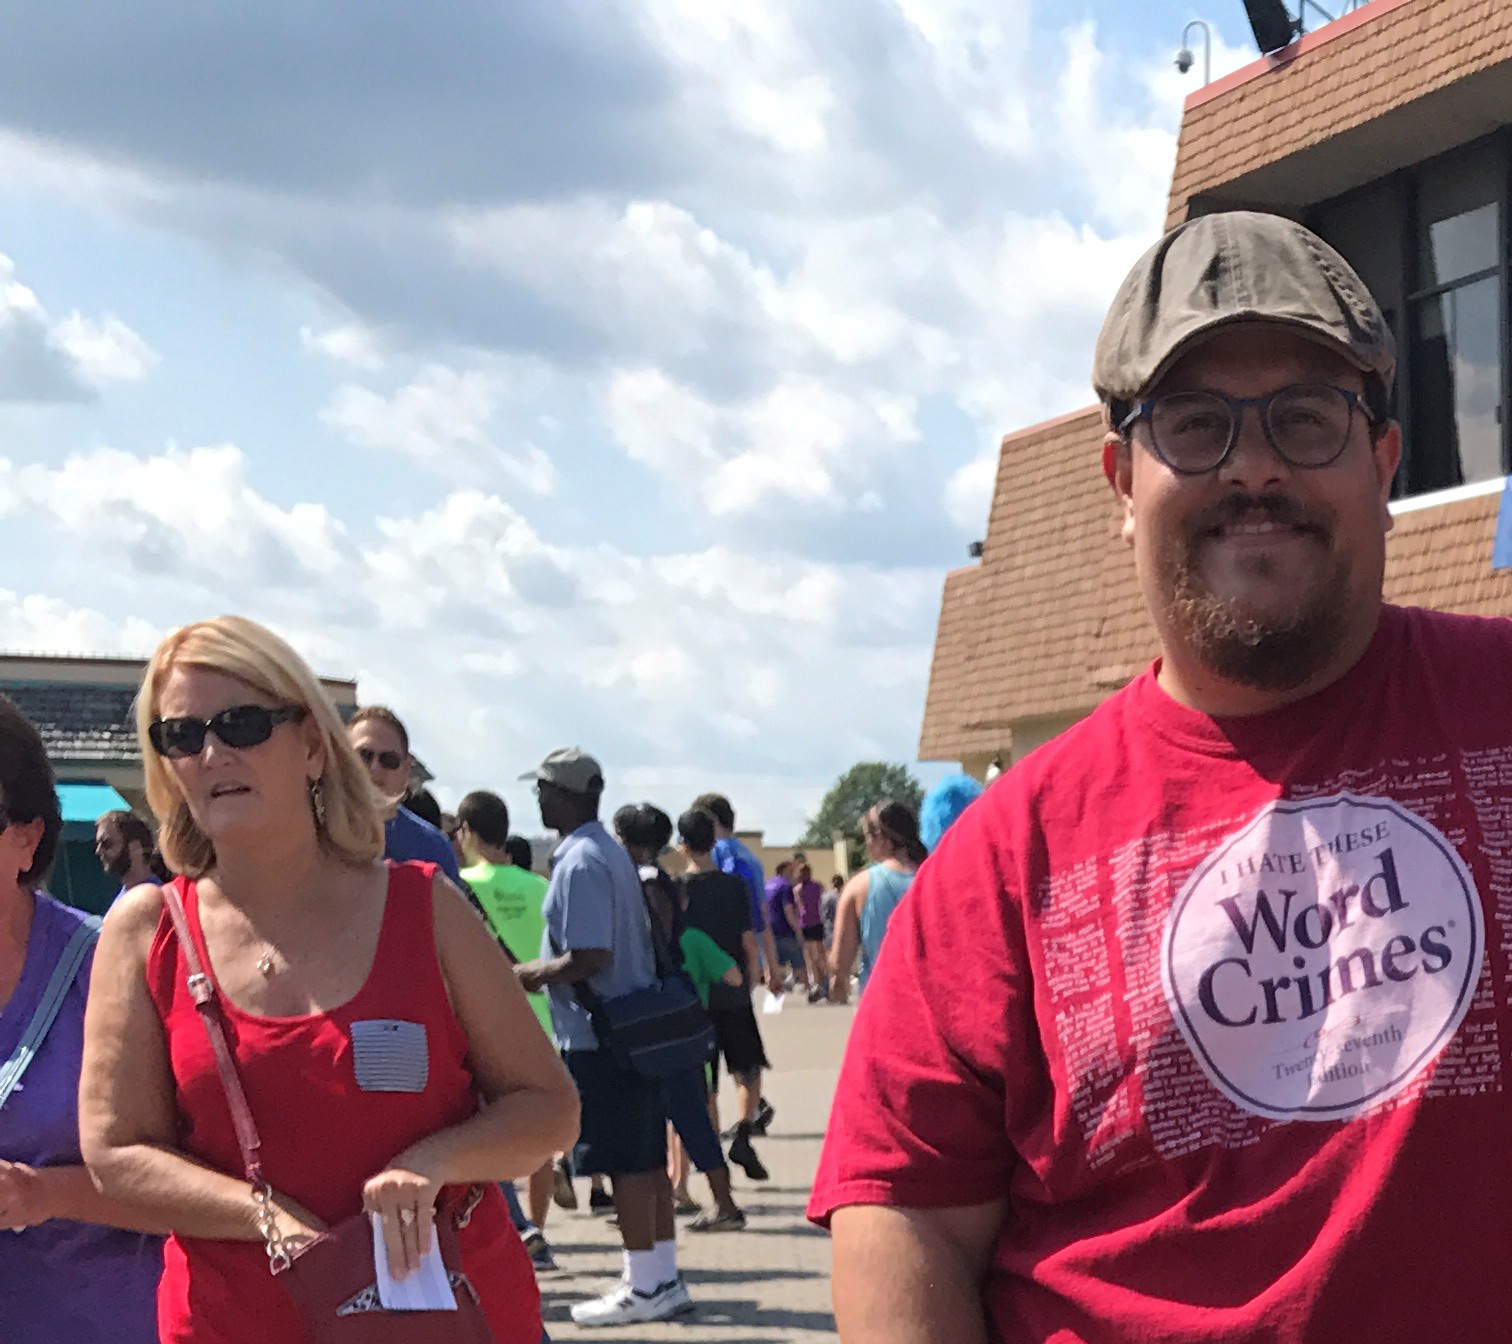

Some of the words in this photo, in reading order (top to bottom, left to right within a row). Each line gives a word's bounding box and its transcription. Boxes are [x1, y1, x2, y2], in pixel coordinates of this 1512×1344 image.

[1220, 868, 1229, 886] I
[1236, 852, 1307, 879] HATE
[1307, 820, 1393, 867] THESE
[1215, 848, 1410, 955] Word
